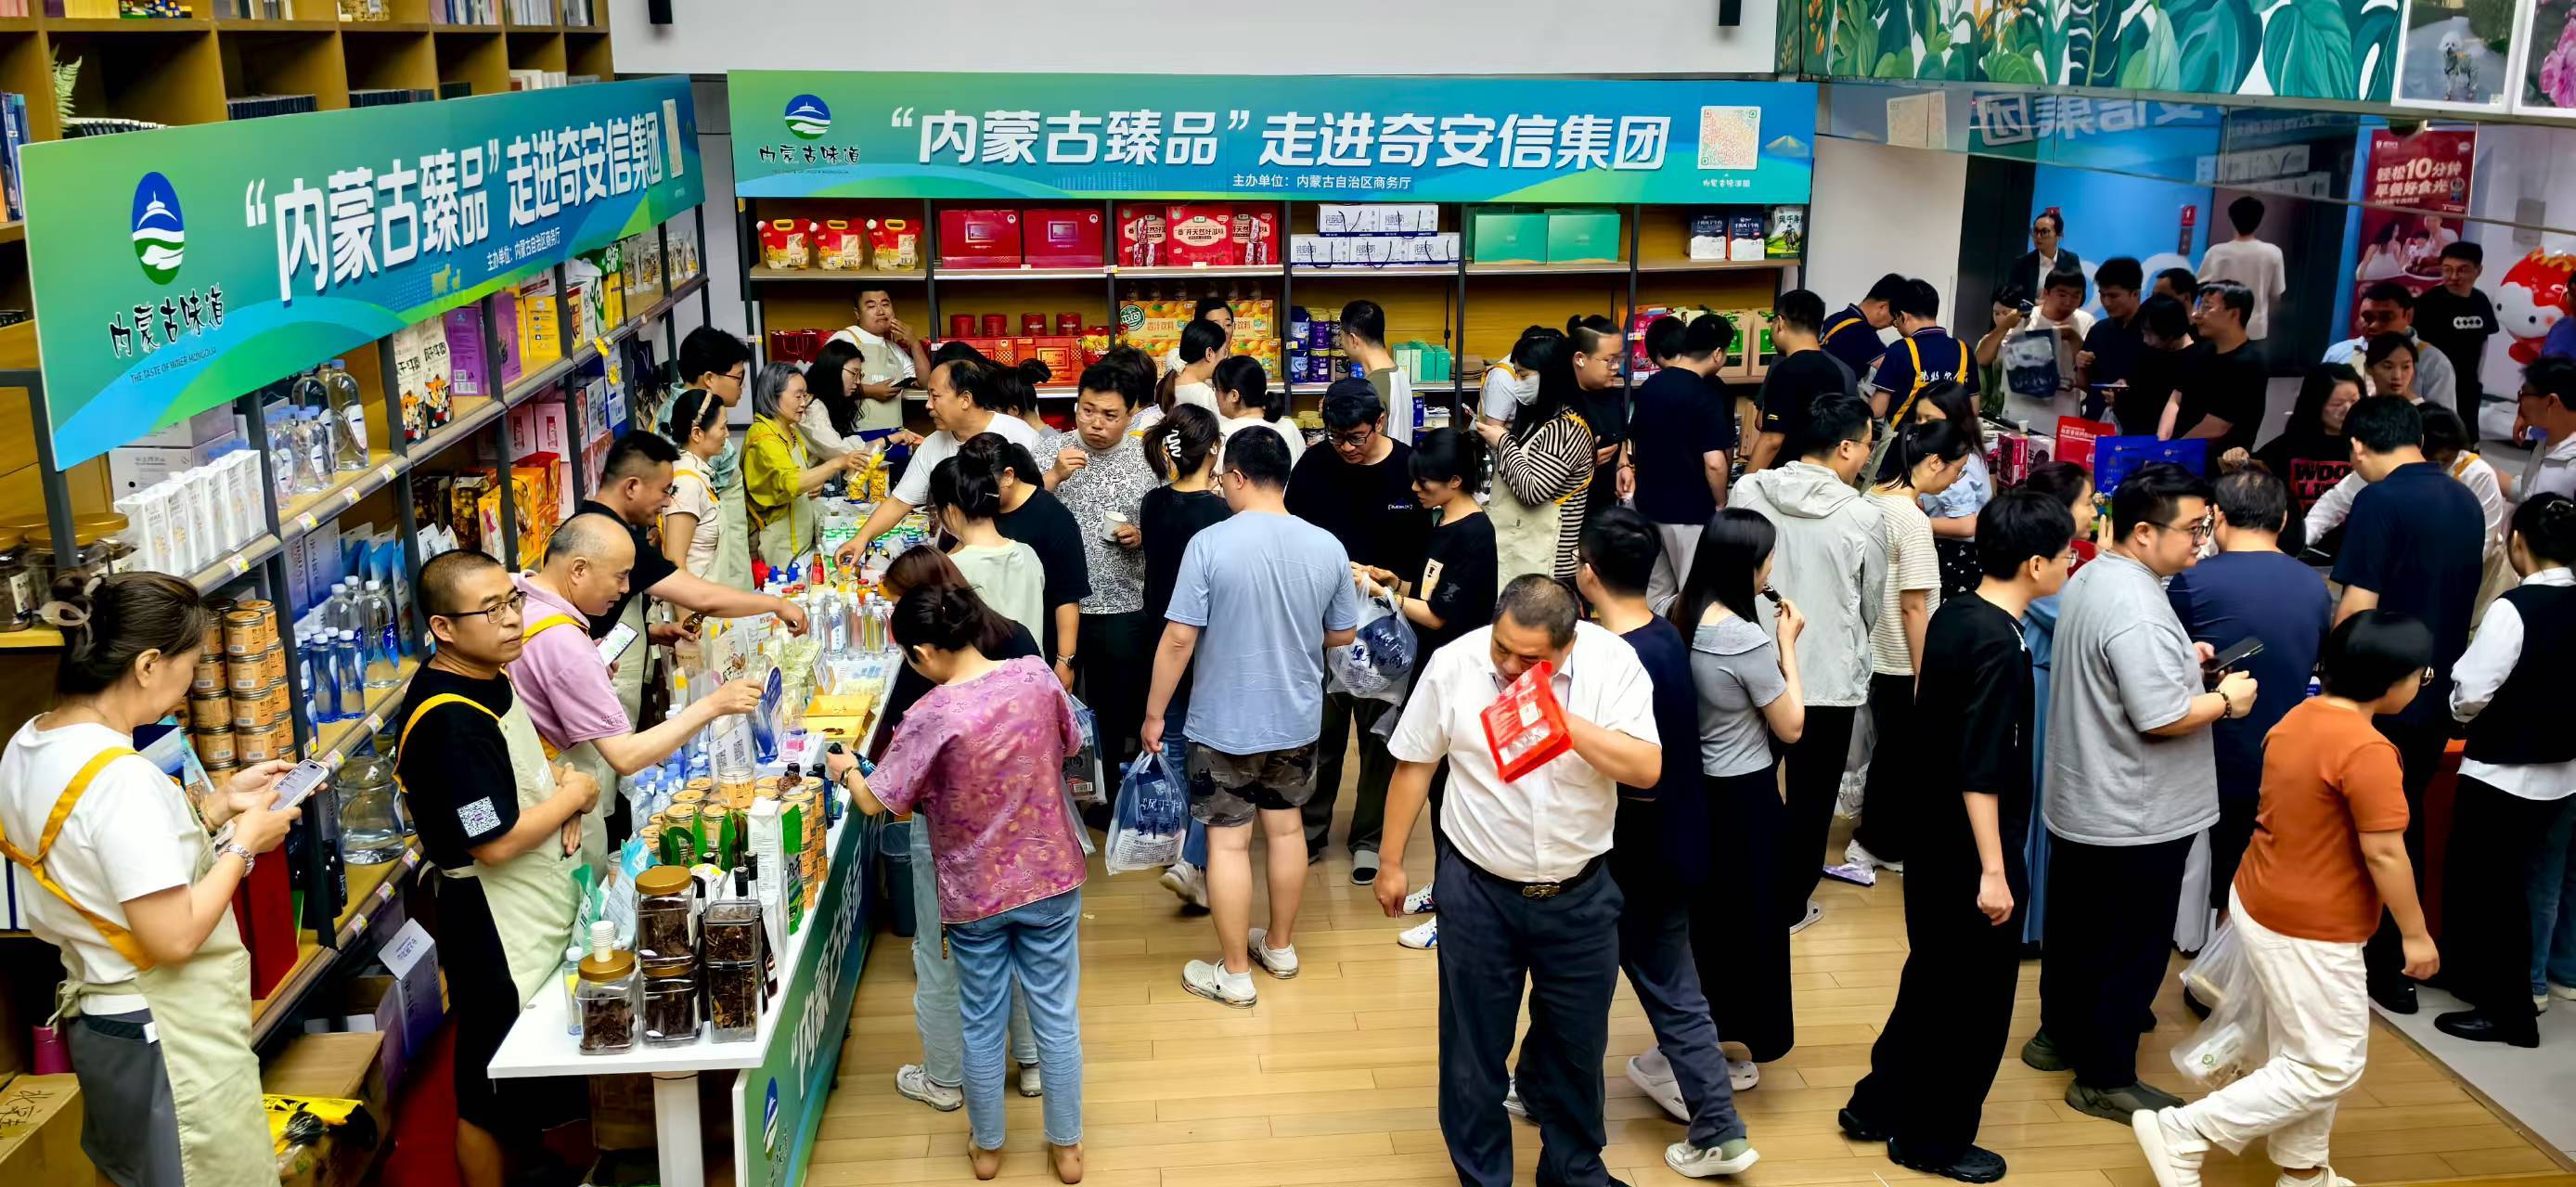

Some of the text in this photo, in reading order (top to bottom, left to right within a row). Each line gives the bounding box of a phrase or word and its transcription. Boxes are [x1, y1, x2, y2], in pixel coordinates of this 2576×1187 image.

[891, 105, 1672, 172] “内蒙古臻品”走进奇安信集团
[758, 144, 861, 164] 内蒙古味道
[2376, 157, 2463, 182] 轻松10分钟
[1232, 174, 1412, 191] 主办单位：内蒙古自治区商务厅
[245, 111, 663, 303] “内蒙古臻品”走进奇安信集团
[108, 282, 225, 358] 内蒙古味道
[131, 372, 142, 383] THE
[144, 366, 161, 380] TASTE
